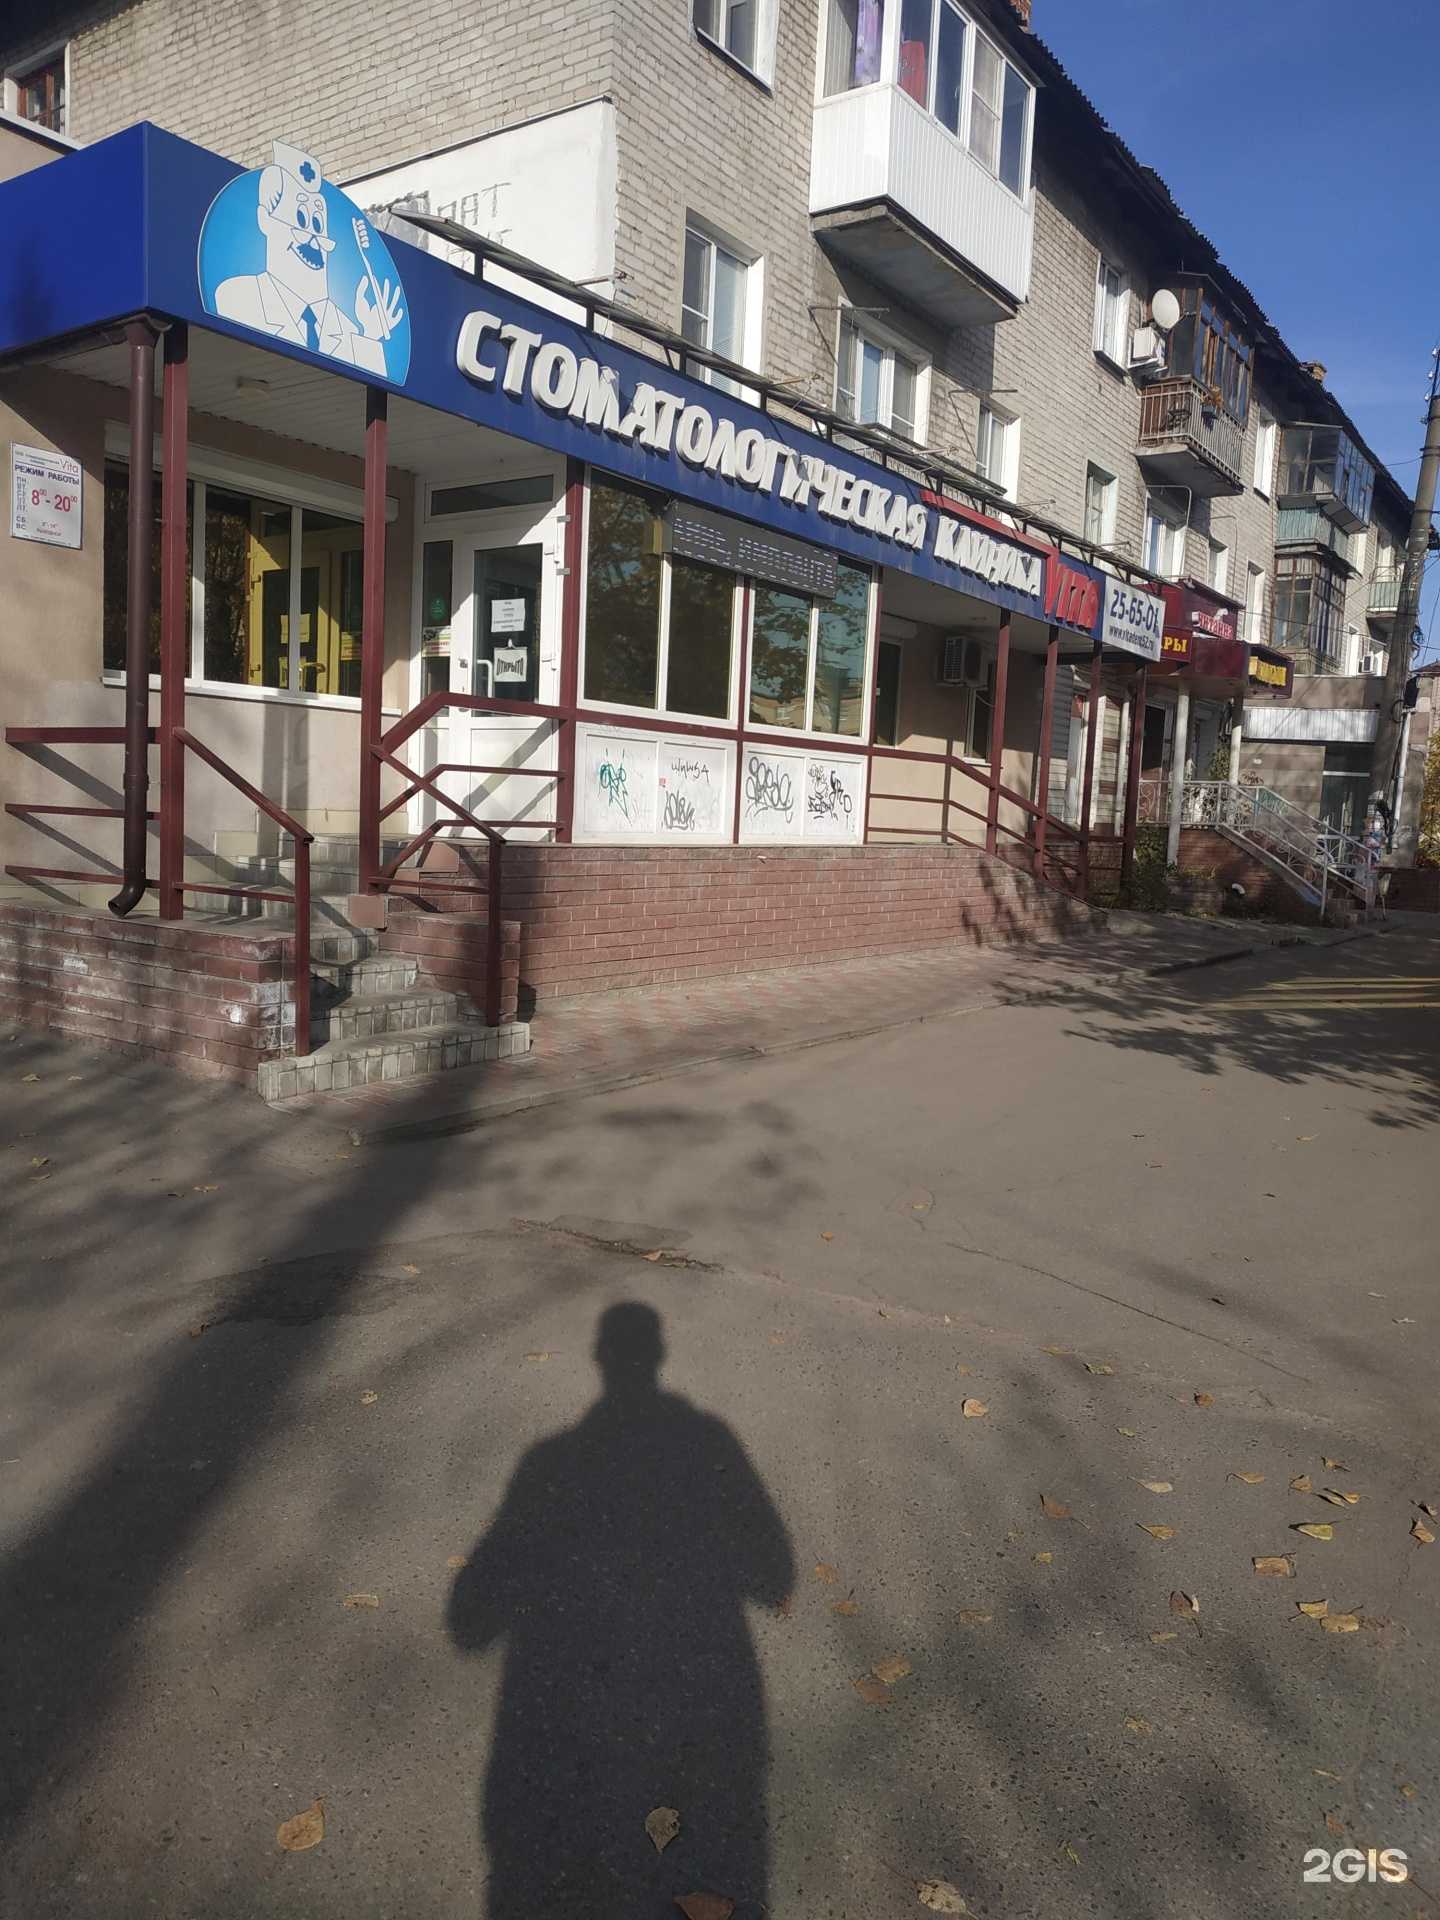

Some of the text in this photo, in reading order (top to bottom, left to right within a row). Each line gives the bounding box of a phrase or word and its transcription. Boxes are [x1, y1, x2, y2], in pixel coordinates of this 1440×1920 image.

[455, 309, 1042, 597] СТОМАТОЛОГИЧЕСКАЯ КЛИНИКА
[15, 463, 80, 486] РЕЖИМ РАБОТЫ
[1161, 635, 1188, 653] РЫ
[496, 657, 524, 676] ОТКРЫТО
